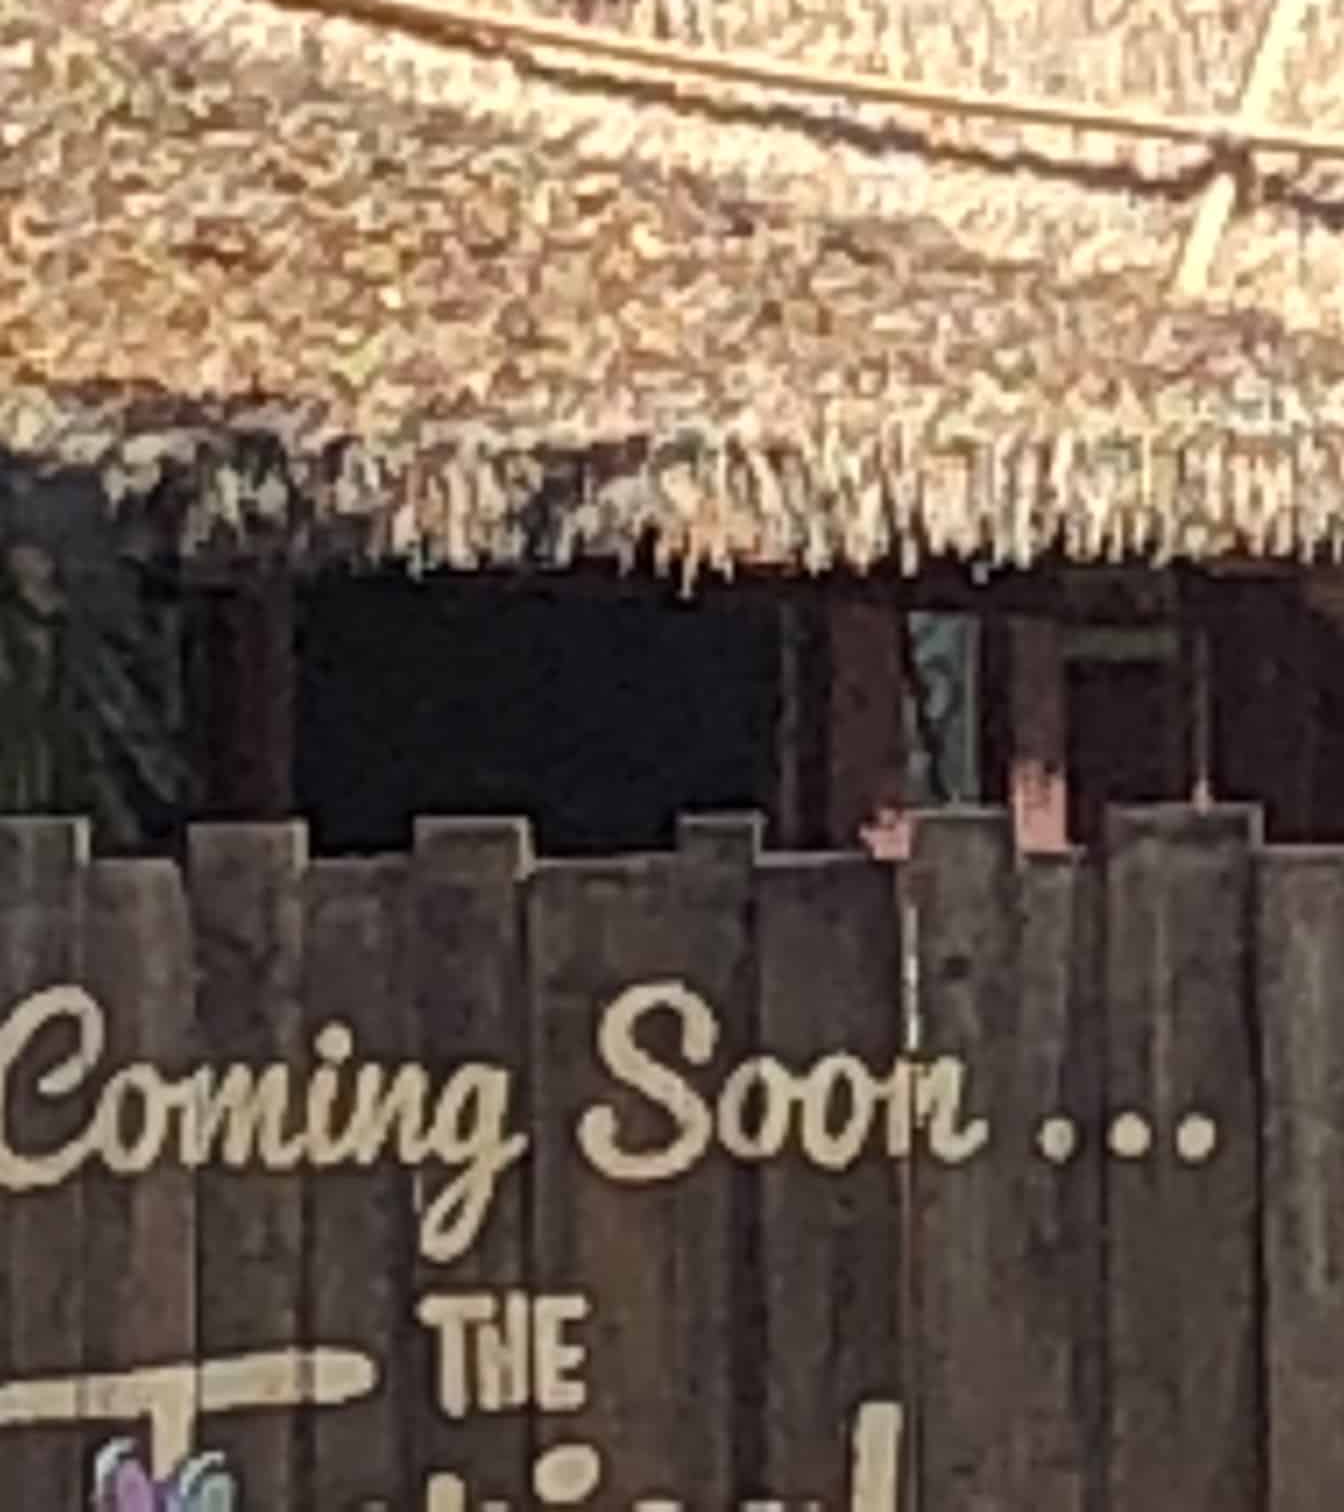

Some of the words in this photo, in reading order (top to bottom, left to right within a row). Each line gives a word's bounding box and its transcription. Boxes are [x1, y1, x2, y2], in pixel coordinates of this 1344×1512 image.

[0, 983, 528, 1264] Coming
[576, 980, 990, 1182] Soon
[418, 1292, 590, 1418] THE
